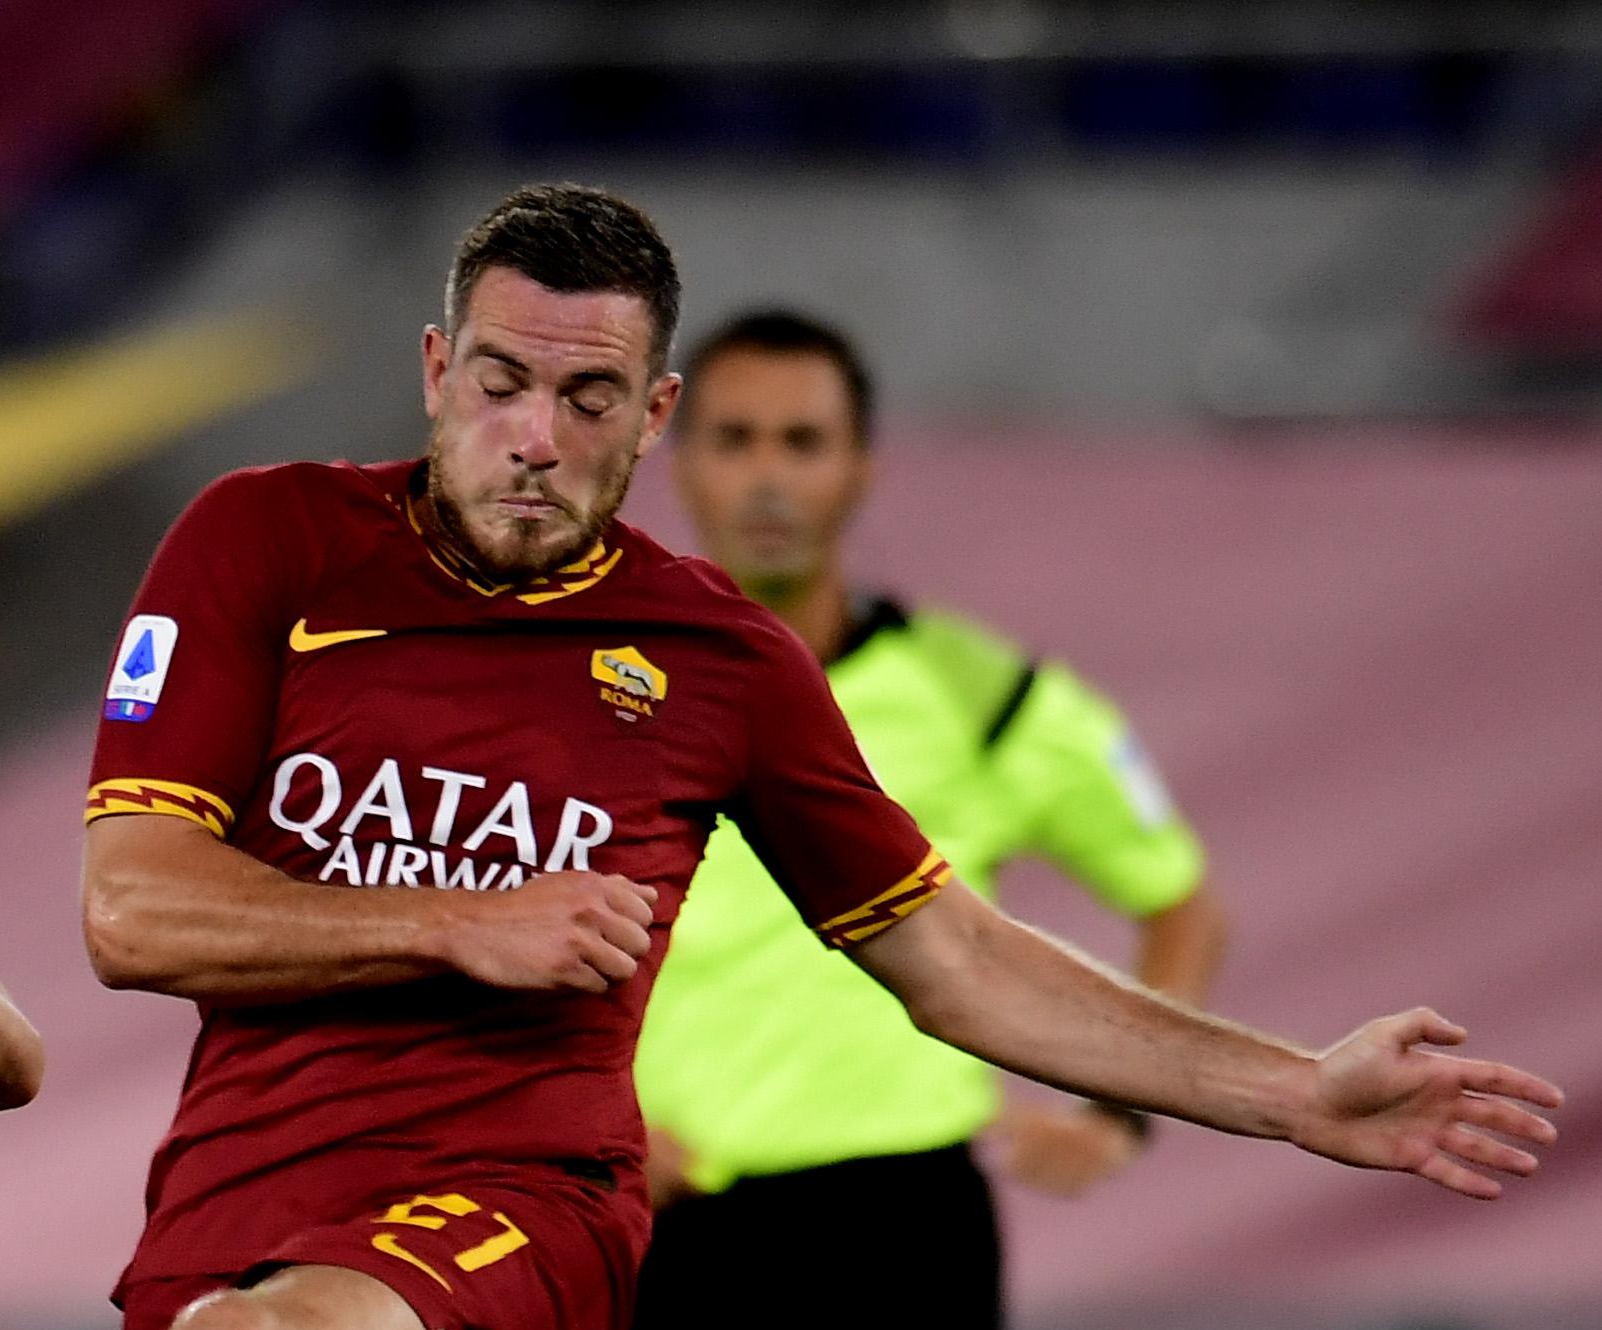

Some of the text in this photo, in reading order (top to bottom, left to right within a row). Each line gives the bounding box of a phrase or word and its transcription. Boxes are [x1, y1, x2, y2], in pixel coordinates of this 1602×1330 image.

[600, 687, 655, 718] ROMA
[268, 751, 614, 873] QATAR
[317, 835, 543, 892] AIRWA
